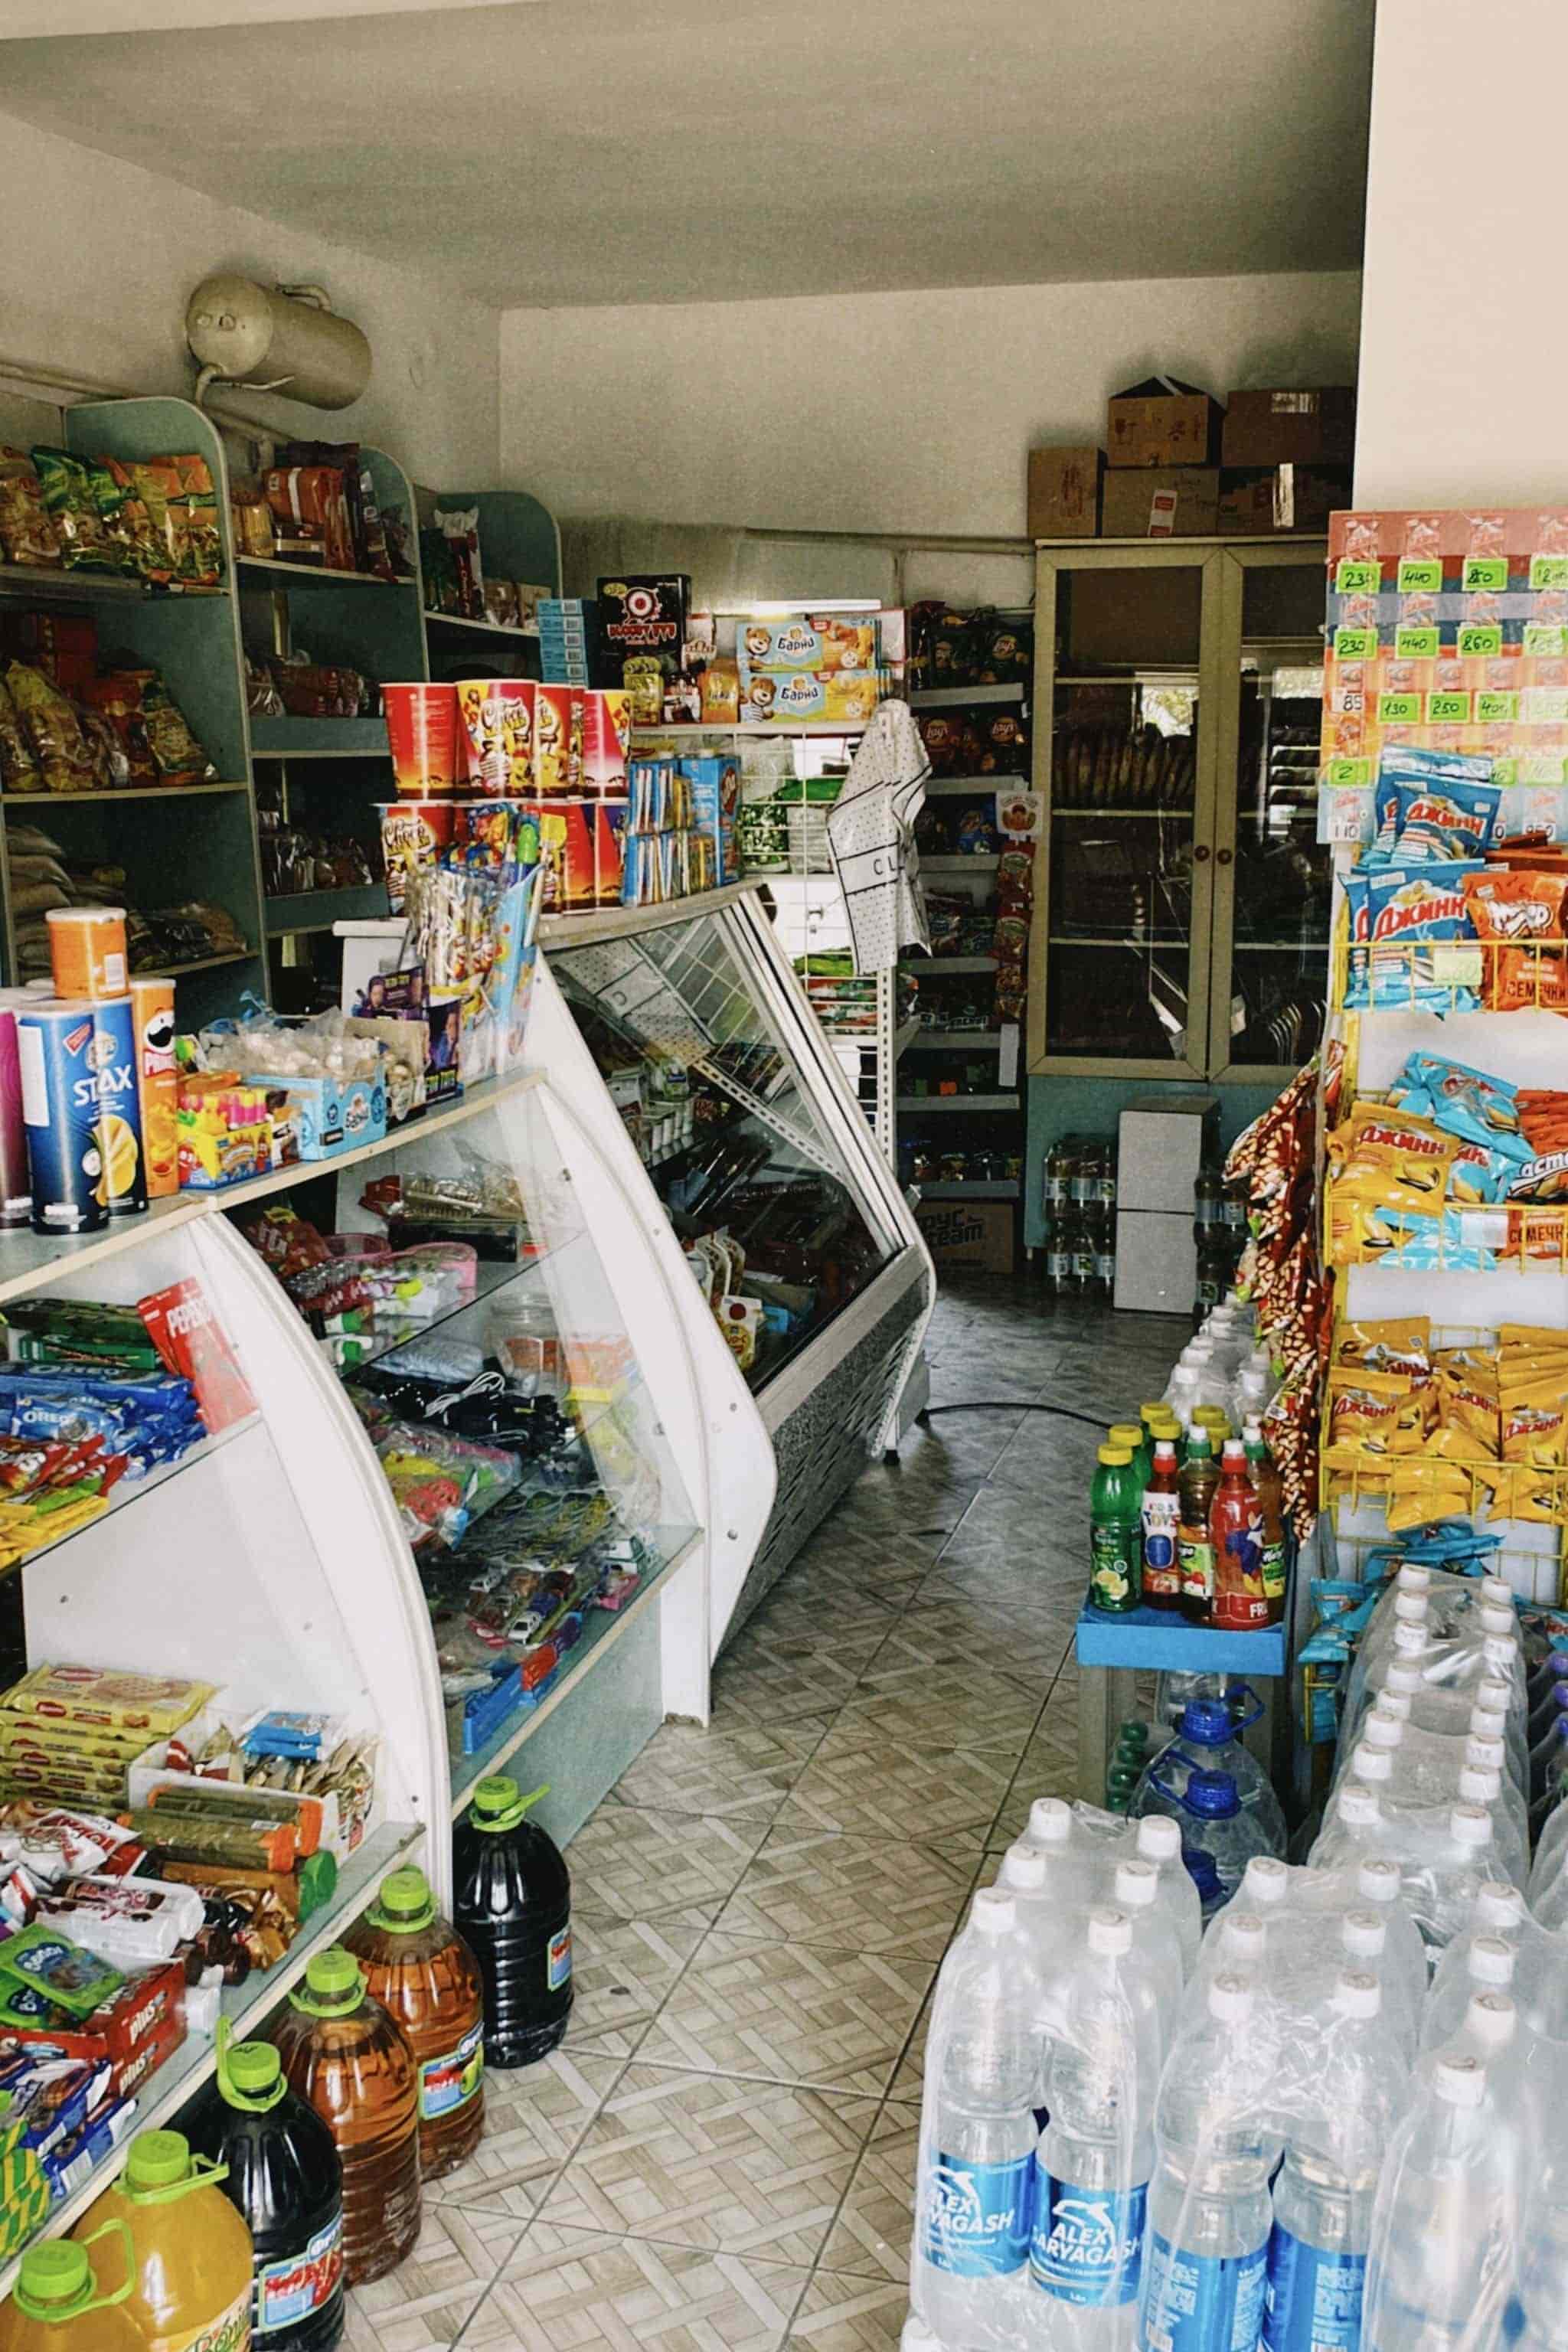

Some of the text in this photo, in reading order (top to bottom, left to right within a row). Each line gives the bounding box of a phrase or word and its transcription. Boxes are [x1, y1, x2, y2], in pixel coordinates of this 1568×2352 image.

[1403, 571, 1432, 584] 440
[777, 637, 815, 652] Барни
[1339, 639, 1366, 655] 230
[1401, 637, 1427, 650] 440
[781, 687, 818, 701] Барни
[1383, 702, 1408, 715] 130
[1432, 701, 1459, 715] 250
[1406, 802, 1485, 838] ДЖИНН
[1334, 825, 1358, 839] 110
[1374, 896, 1466, 942] ДЖИНН
[73, 1064, 135, 1108] STAX
[1359, 1125, 1448, 1155] ДЖИНН
[1334, 1396, 1396, 1417] ДЖИНН
[1505, 1413, 1564, 1440] ДЖИНН
[1051, 2222, 1109, 2246] ALEX
